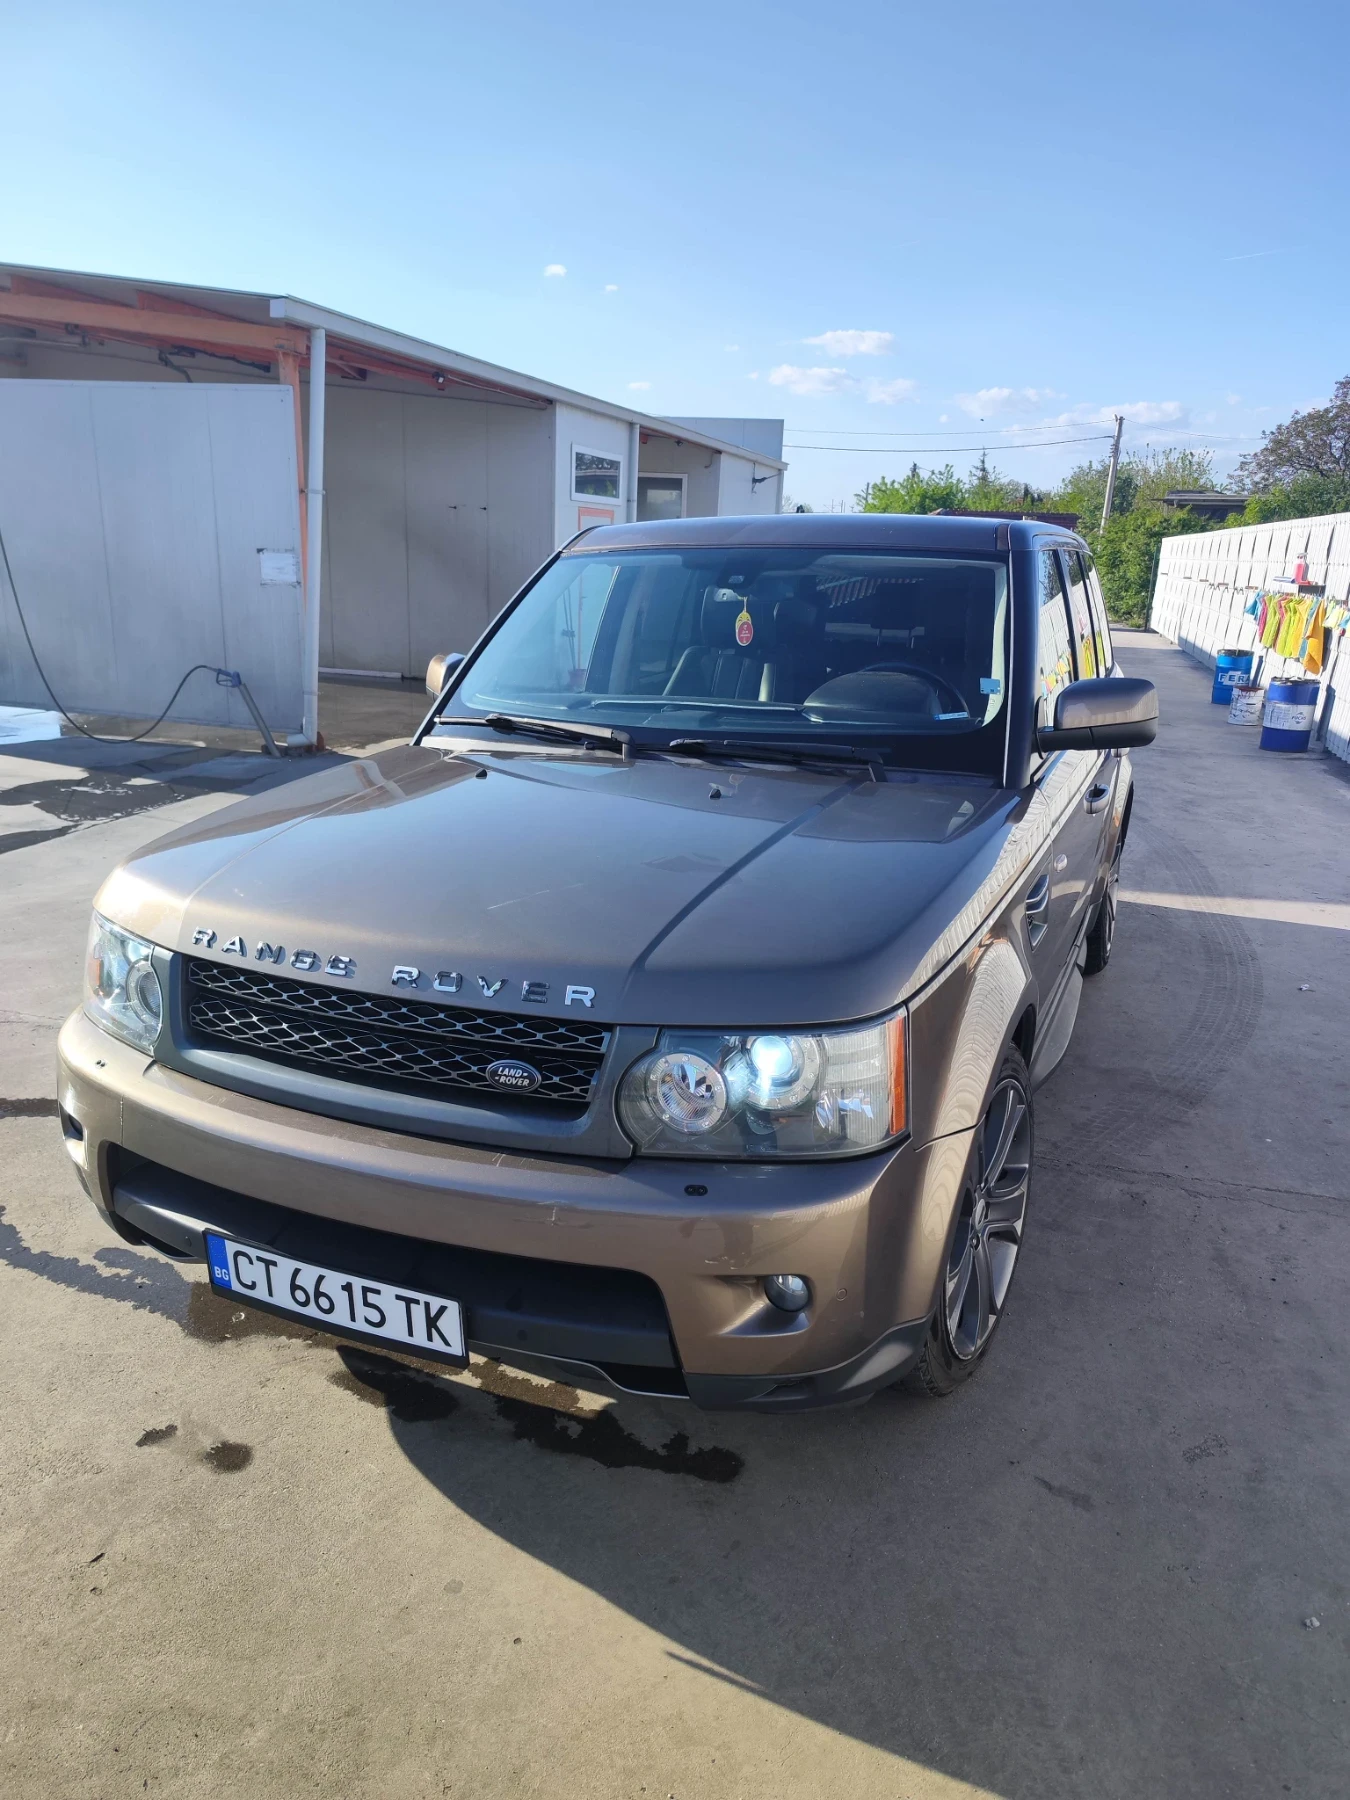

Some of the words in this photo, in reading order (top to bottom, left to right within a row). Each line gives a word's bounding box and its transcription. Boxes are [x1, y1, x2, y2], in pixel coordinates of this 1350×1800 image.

[192, 926, 352, 977] RANGE
[391, 964, 597, 1008] ROVER
[214, 1266, 229, 1281] BG
[232, 1250, 278, 1297] CT
[290, 1268, 386, 1328] 6615
[395, 1294, 452, 1347] TK
